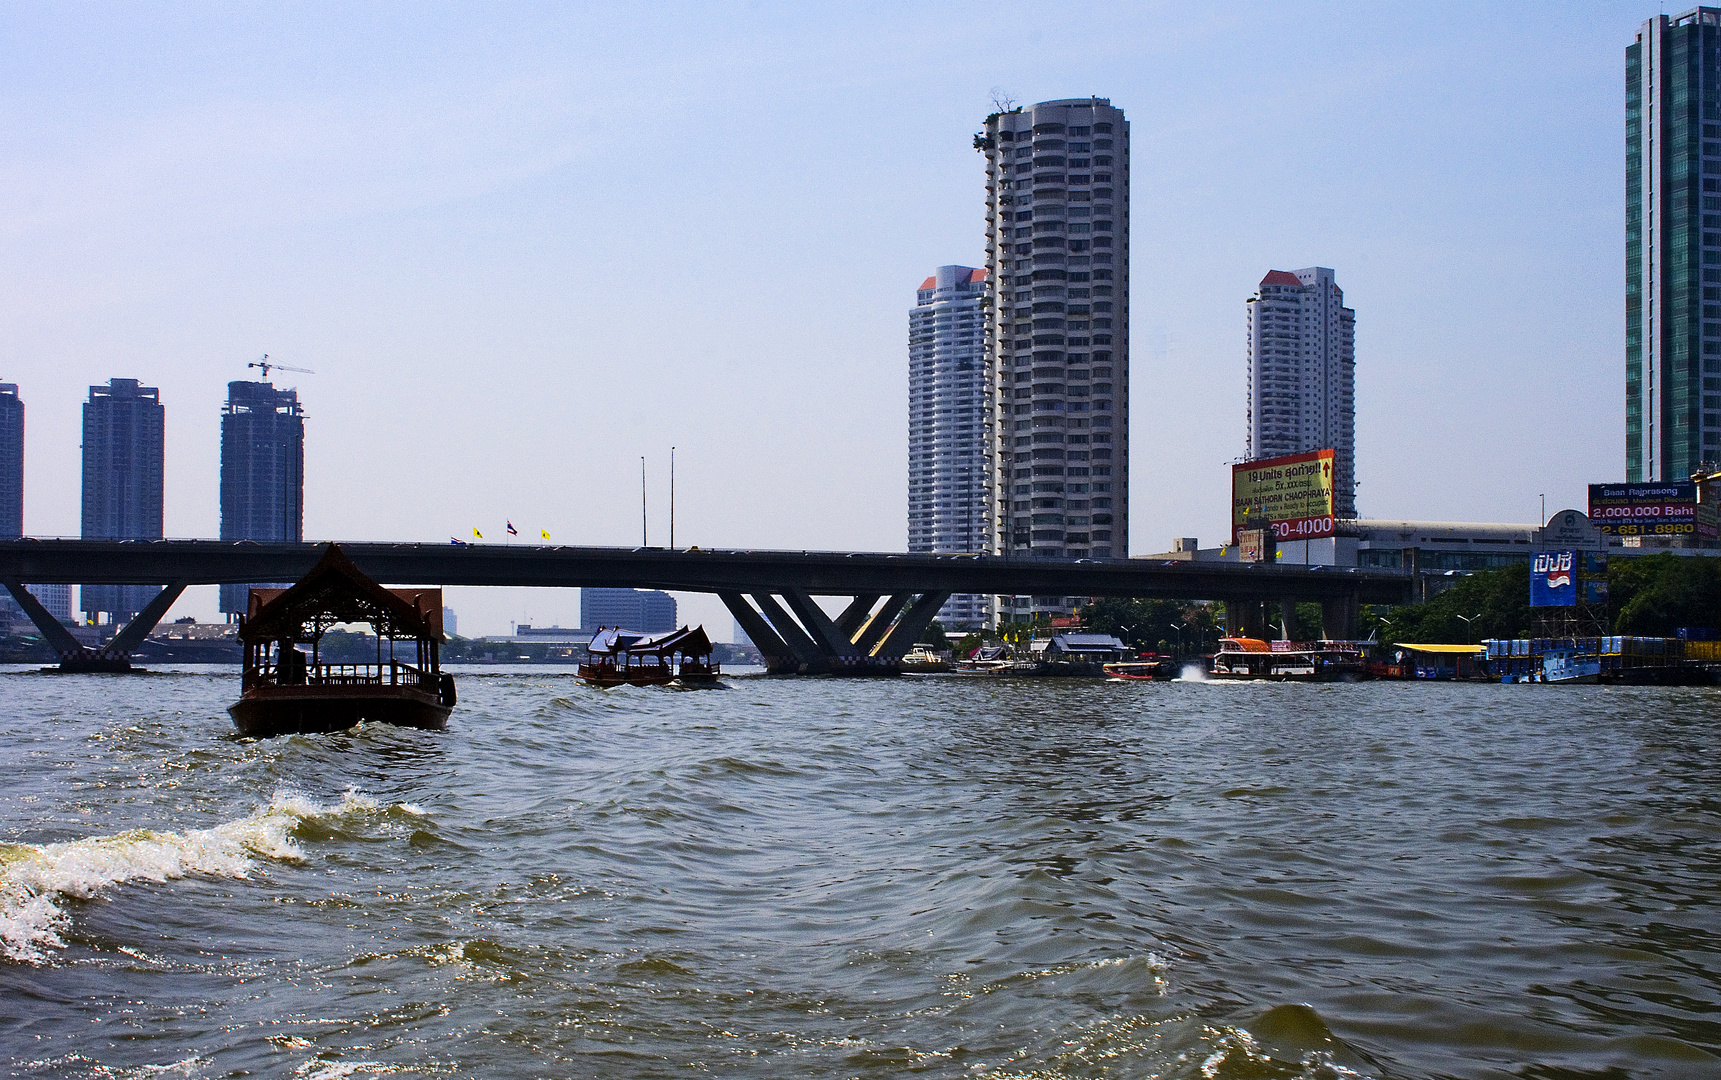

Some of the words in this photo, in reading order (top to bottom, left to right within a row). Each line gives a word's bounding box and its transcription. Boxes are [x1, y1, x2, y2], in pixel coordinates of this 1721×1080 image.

[1248, 471, 1258, 482] 19
[1259, 469, 1282, 481] Units
[1236, 497, 1253, 507] BAAN
[1253, 493, 1283, 505] SATHORN
[1284, 487, 1330, 501] CHAOPHRAYA
[1603, 489, 1626, 497] Baan
[1628, 487, 1678, 497] Rajprasong
[1593, 506, 1660, 518] 2,000,000
[1664, 506, 1694, 516] Baht
